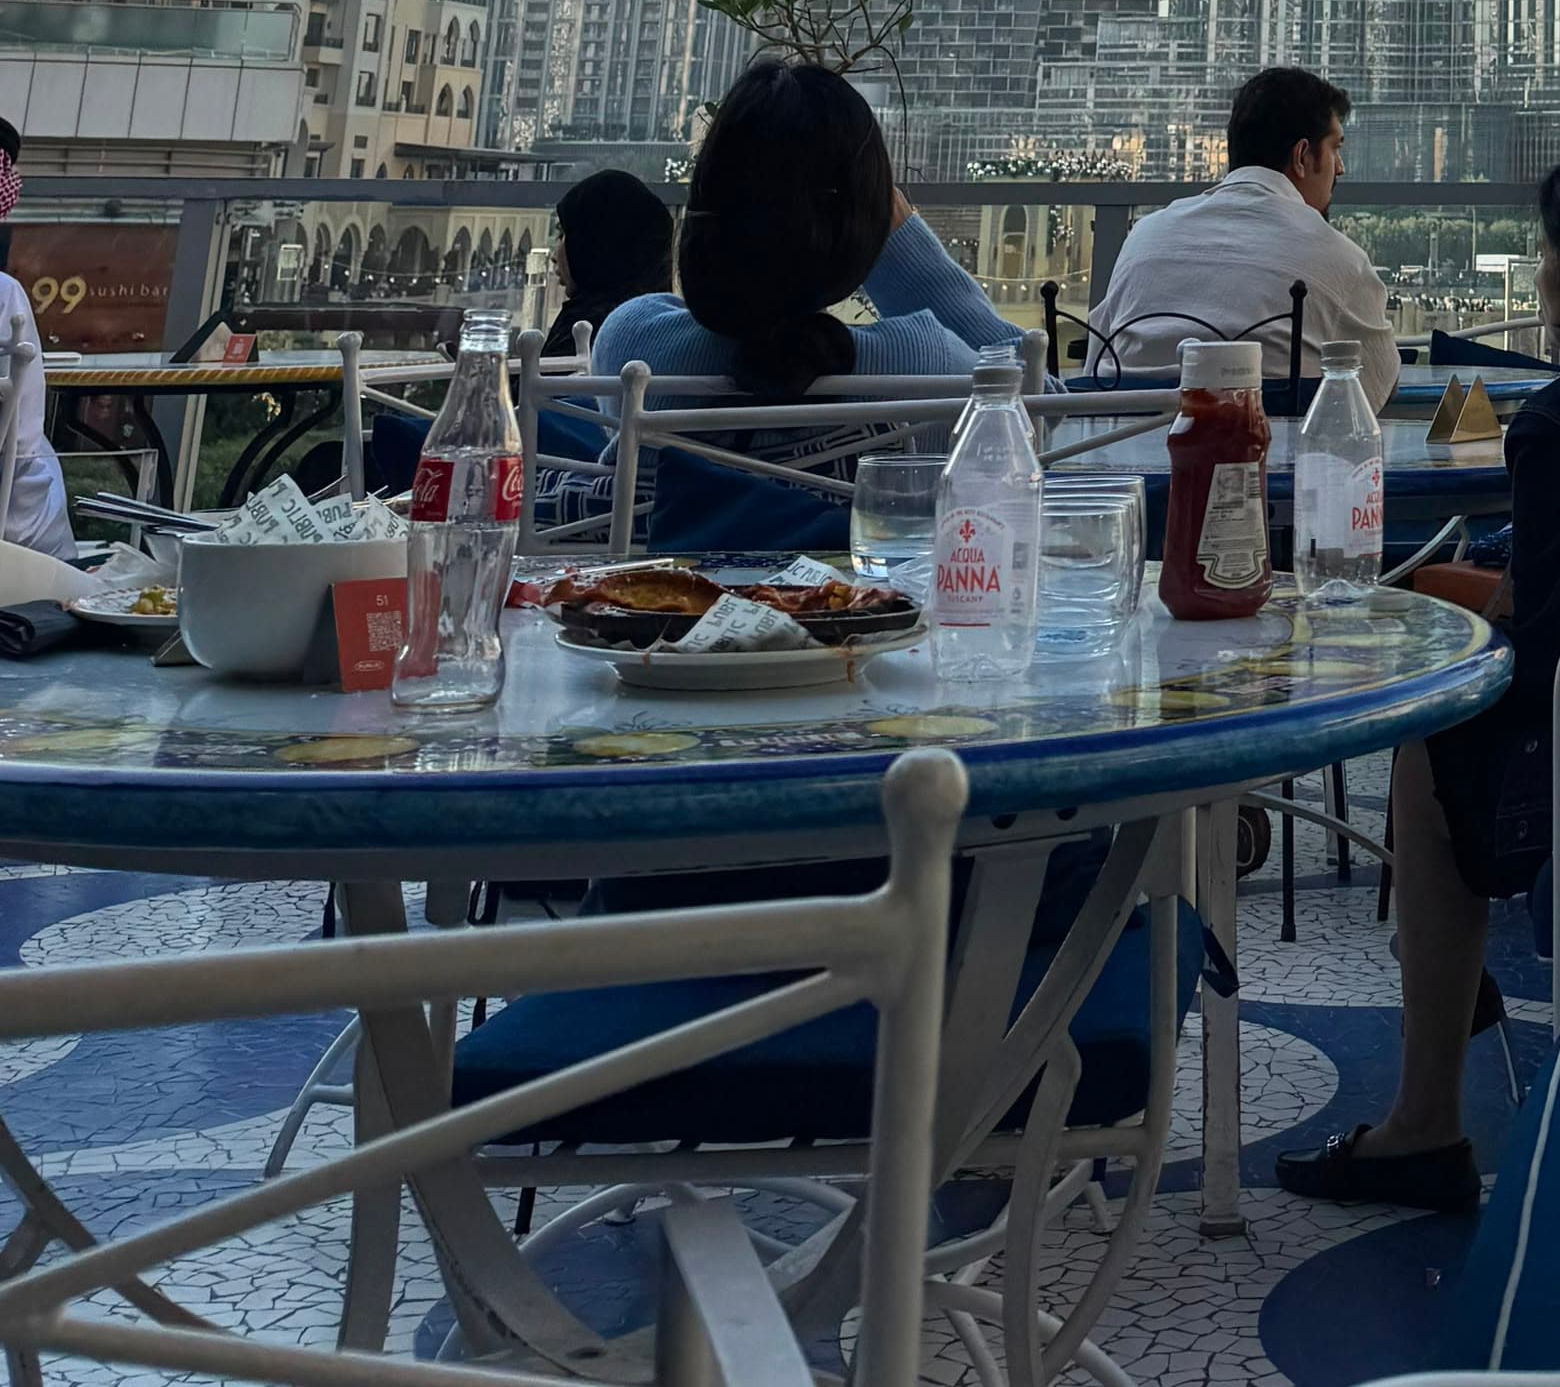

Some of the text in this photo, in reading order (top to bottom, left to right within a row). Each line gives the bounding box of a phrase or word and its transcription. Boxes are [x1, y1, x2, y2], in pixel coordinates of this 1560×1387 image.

[32, 276, 168, 314] 99 sushi bar
[1352, 506, 1383, 531] PAN
[950, 547, 985, 564] ACQUA
[937, 565, 1001, 592] PANNA
[376, 594, 389, 607] 51
